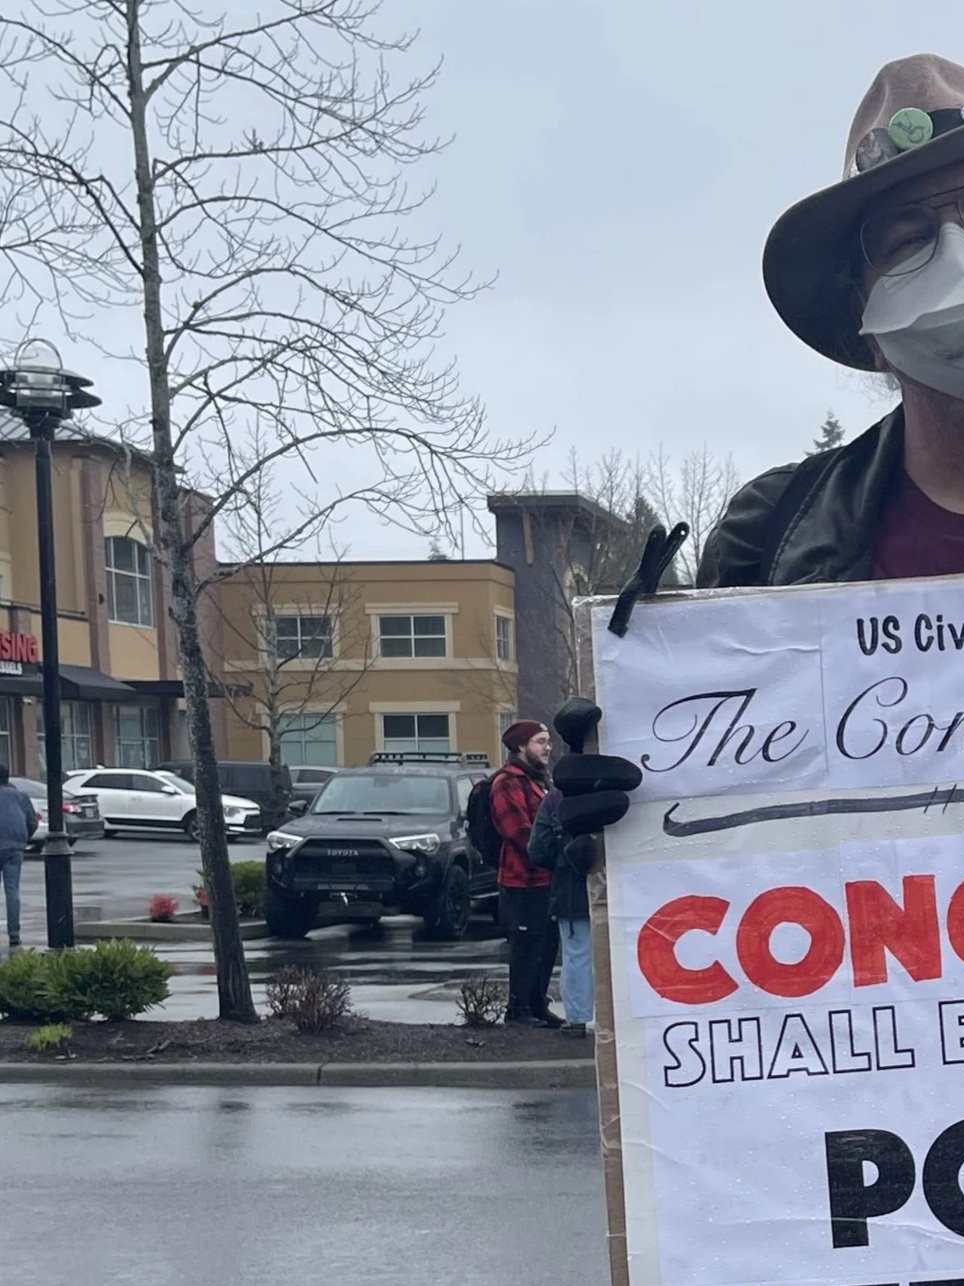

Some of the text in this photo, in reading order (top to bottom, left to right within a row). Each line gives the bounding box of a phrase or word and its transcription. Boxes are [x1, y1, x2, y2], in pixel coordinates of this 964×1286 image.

[0, 631, 39, 663] SING
[857, 614, 903, 656] US
[640, 687, 808, 772] The
[327, 849, 359, 857] TOYOTA
[663, 1006, 915, 1088] SHALL
